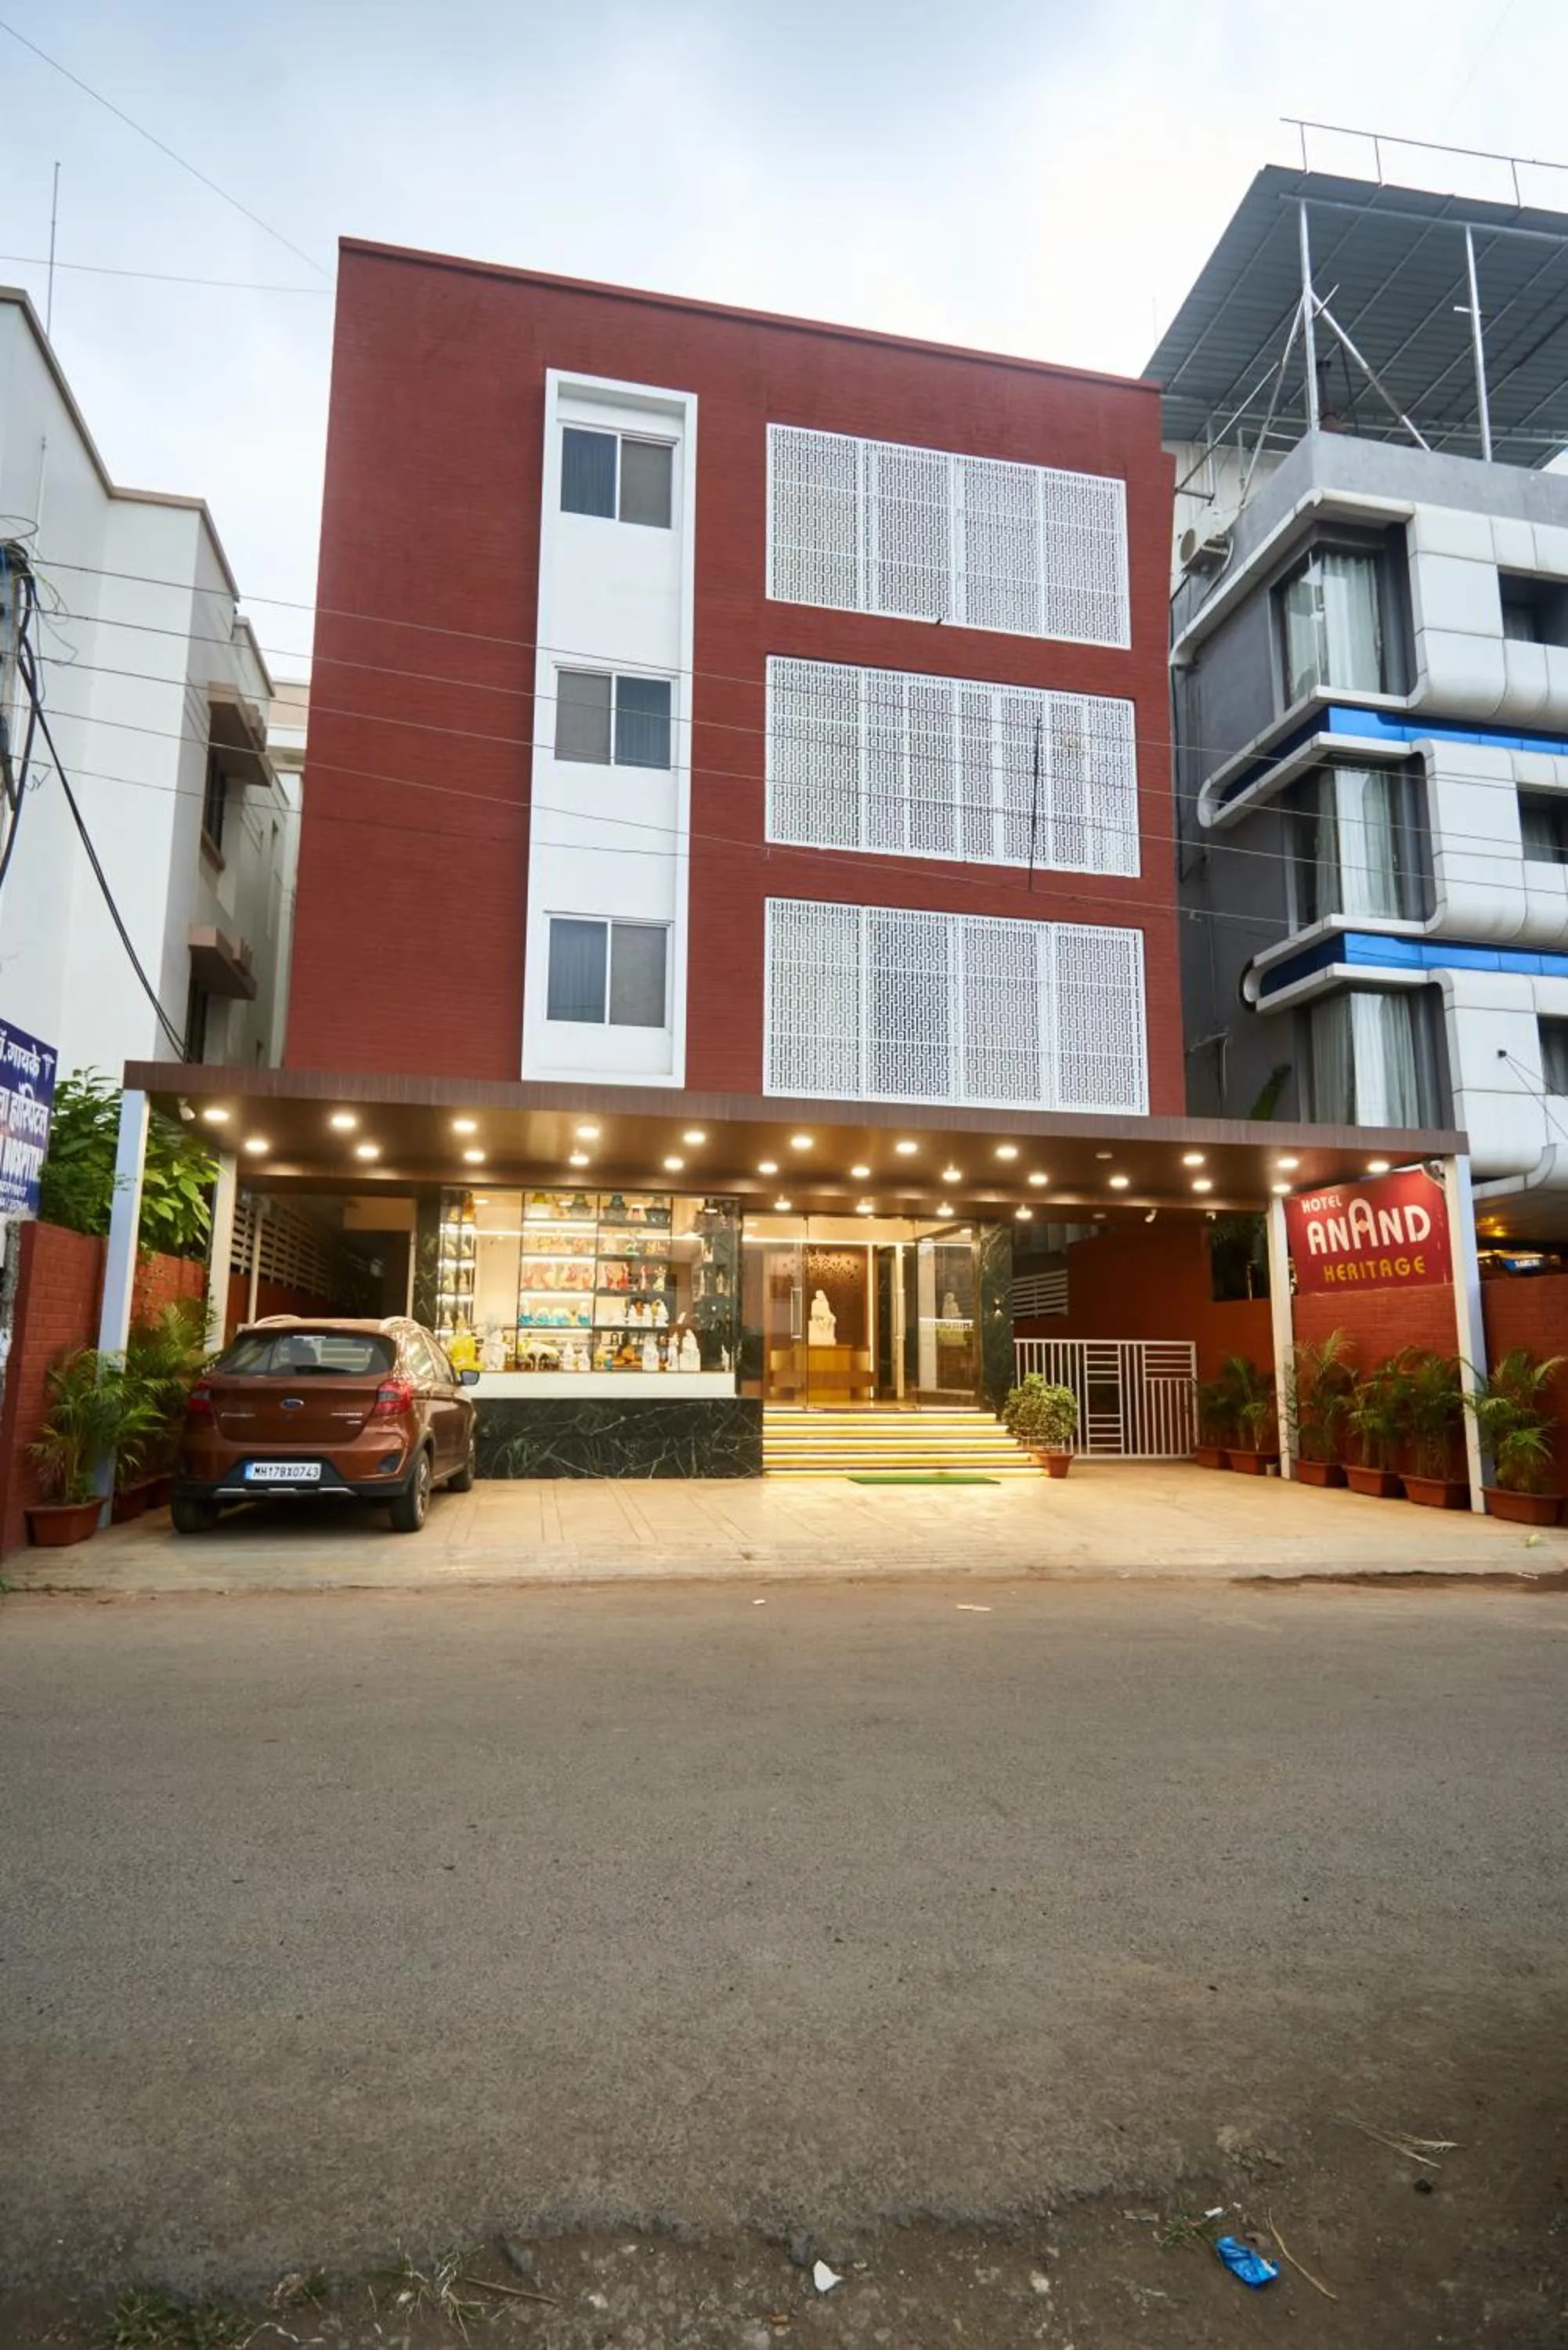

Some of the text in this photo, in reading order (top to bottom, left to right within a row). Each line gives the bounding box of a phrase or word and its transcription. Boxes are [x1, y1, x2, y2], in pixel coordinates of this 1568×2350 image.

[1301, 1193, 1342, 1213] HOTEL
[1306, 1198, 1431, 1256] ANAND
[1323, 1255, 1426, 1283] HERITAGE
